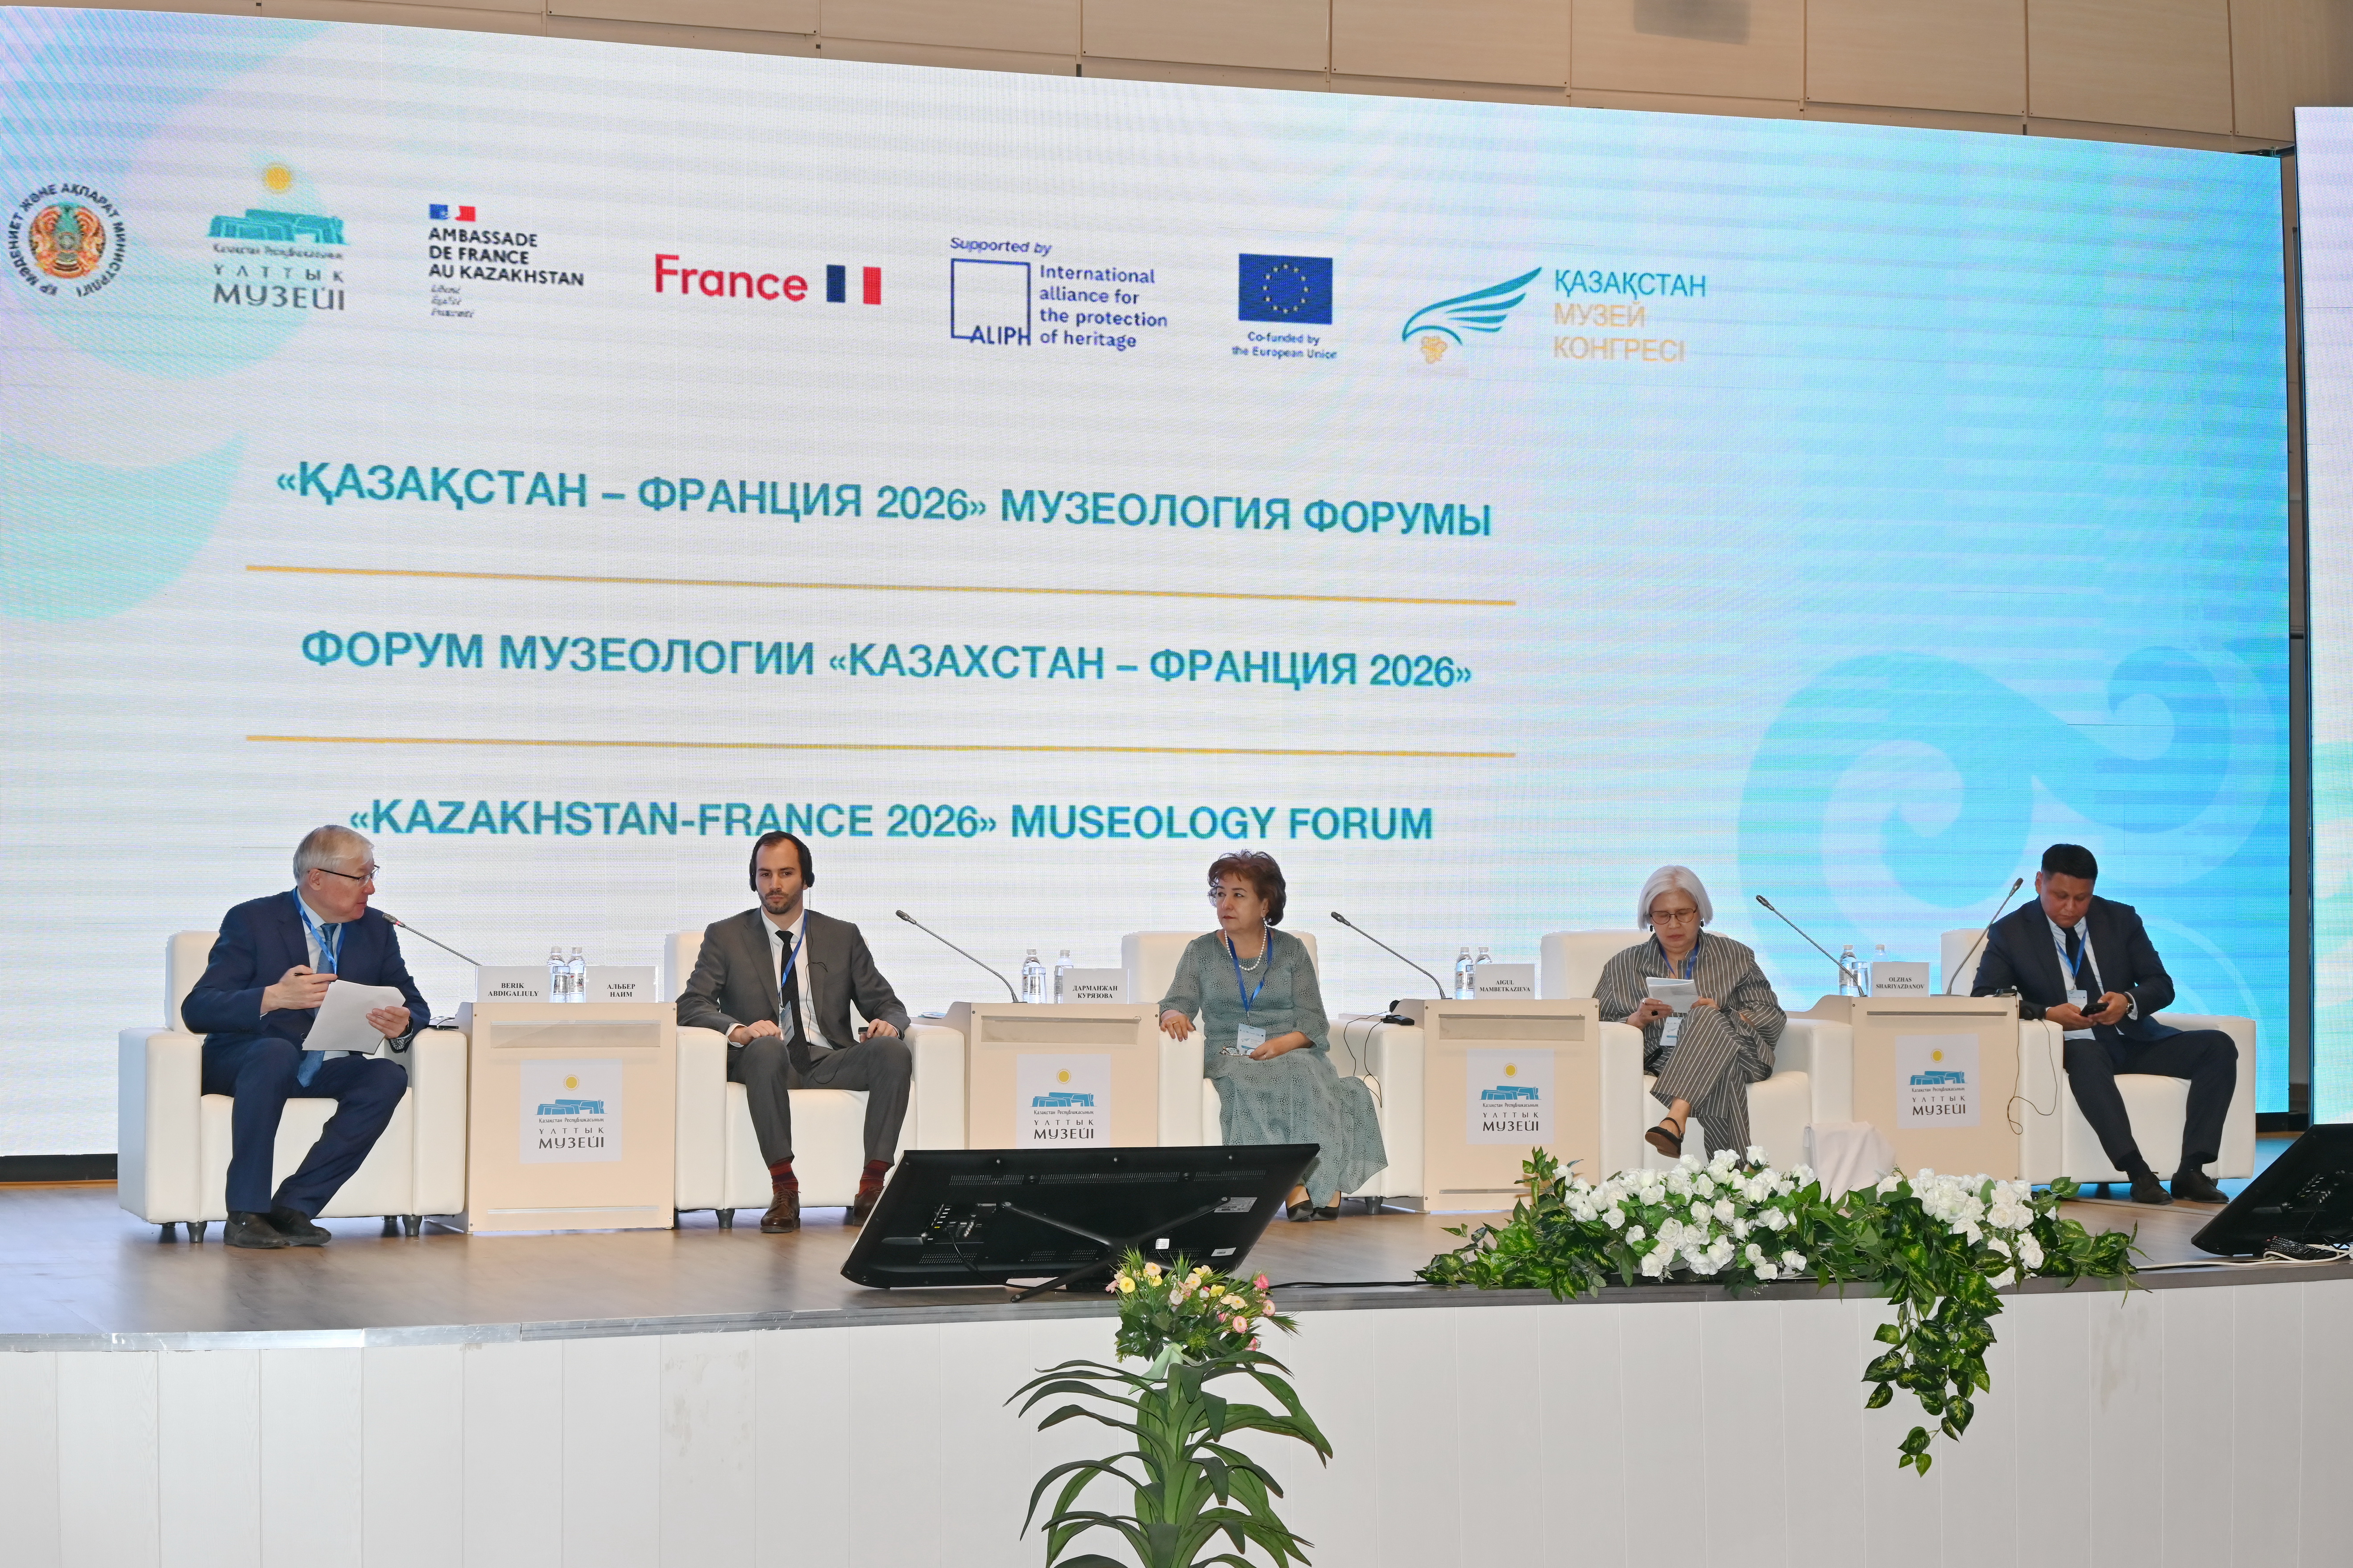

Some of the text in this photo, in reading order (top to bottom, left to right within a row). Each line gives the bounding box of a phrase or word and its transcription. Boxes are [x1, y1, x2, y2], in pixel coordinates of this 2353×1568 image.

[429, 227, 538, 247] AMBASSADE
[951, 238, 1052, 257] Supported by
[430, 245, 529, 264] DE FRANCE
[429, 264, 583, 286] AU KAZAKHSTAN
[656, 254, 808, 301] France
[1041, 265, 1154, 283] International
[1555, 270, 1706, 299] ҚАЗАҚСТАН
[213, 283, 345, 311] МУЗЕЙІ
[1040, 286, 1138, 304] alliance for
[1040, 308, 1167, 327] the protection
[1554, 301, 1646, 327] МУЗЕЙ
[970, 325, 1031, 346] ALIPH
[1040, 329, 1137, 351] of heritage
[1554, 336, 1685, 363] КОНГРЕСІ
[277, 462, 587, 510] «ҚАЗАҚСТАН
[638, 477, 861, 523] ФРАНЦИЯ
[877, 486, 986, 520] 2026»
[1002, 489, 1290, 530] МУЗЕОЛОГИЯ
[1304, 500, 1491, 536] ФОРУМЫ
[302, 630, 483, 668] ФОРУМ
[500, 635, 813, 675] МУЗЕОЛОГИИ
[830, 644, 1104, 679] «КАЗАХСТАН
[1150, 649, 1356, 691] ФРАНЦИЯ
[1370, 654, 1472, 688] 2026»
[350, 799, 1432, 840] «KAZAKHSTAN-FRANCE 2026» MUSEOLOGY FORUM
[1913, 1104, 1965, 1115] МУЗЕЙІ
[1034, 1128, 1093, 1139] МУЗЕЙІ
[1483, 1120, 1538, 1131] МУЗЕЙІ
[539, 1136, 604, 1149] МУЗЕЙІ
